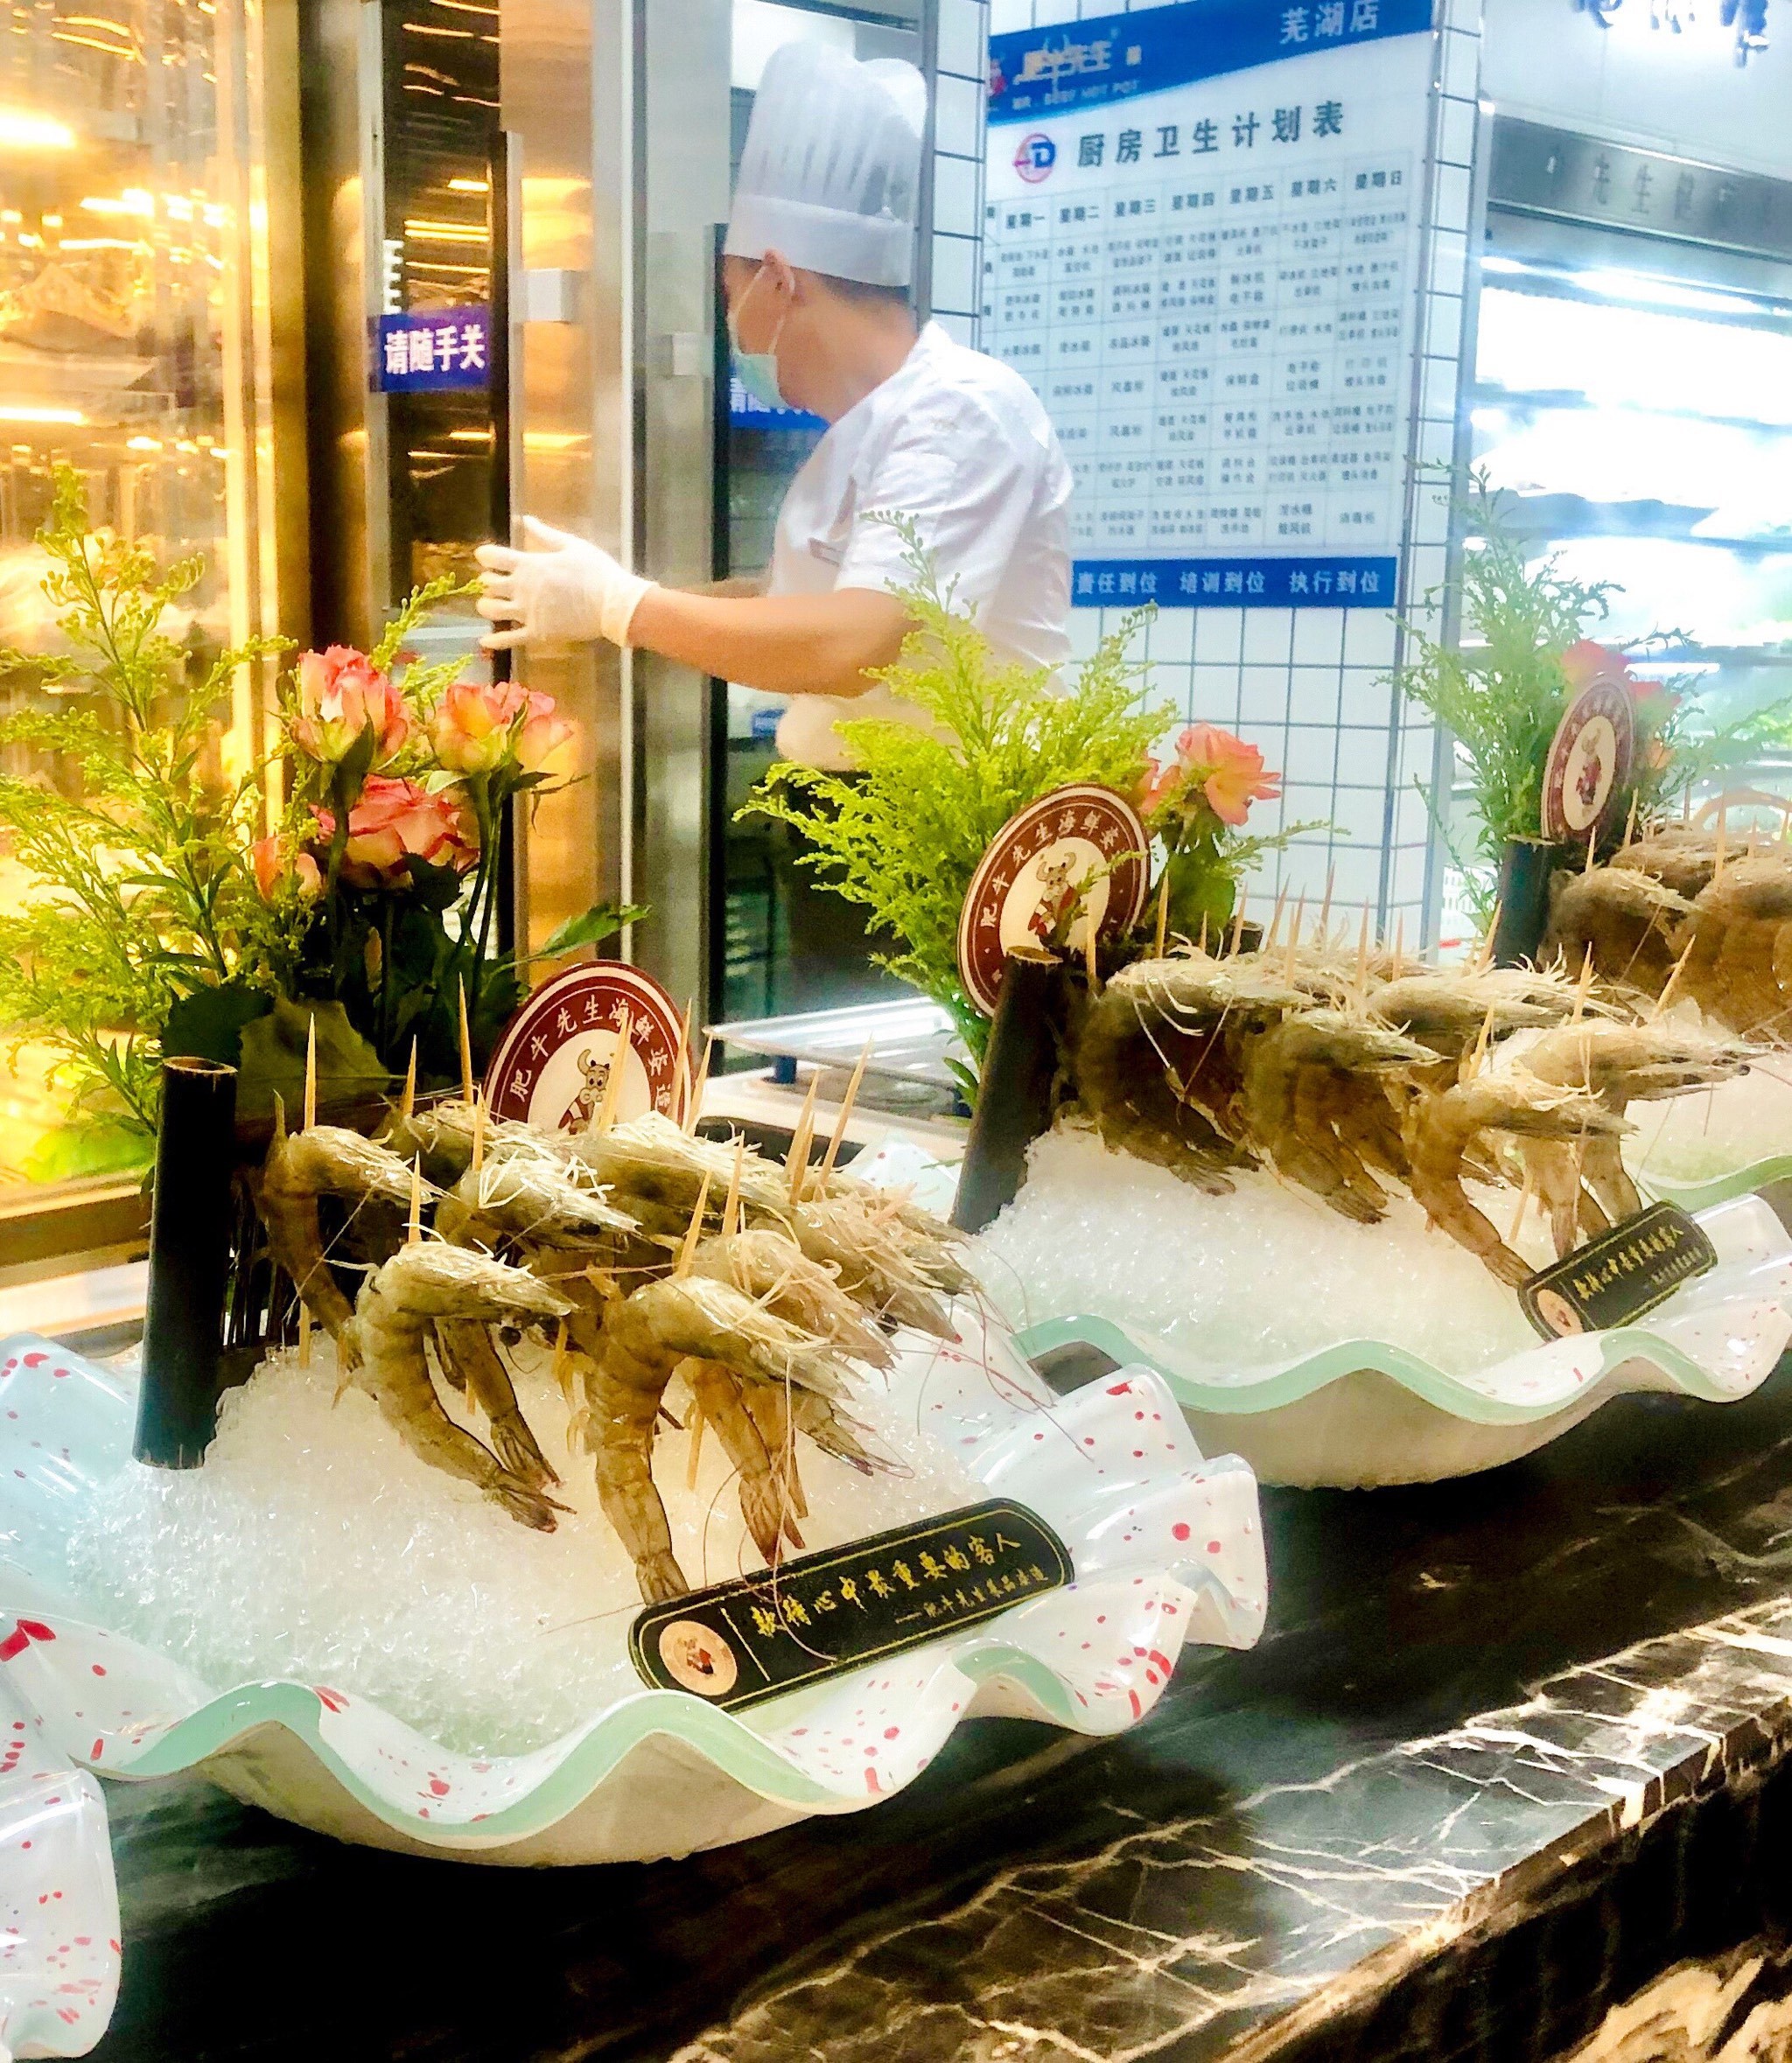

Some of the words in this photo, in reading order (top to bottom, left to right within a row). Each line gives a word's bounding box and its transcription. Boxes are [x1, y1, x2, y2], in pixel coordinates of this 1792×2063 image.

[1279, 0, 1379, 44] 芜湖店
[1077, 101, 1343, 167] 厨房卫生计划表
[1006, 213, 1045, 229] 星期一
[1060, 206, 1099, 223] 星期二
[1115, 199, 1156, 217] 星期三
[1230, 184, 1273, 204] 星期五
[1292, 178, 1337, 197] 星期六
[1355, 170, 1402, 190] 星期日
[384, 324, 486, 374] 请随手关
[1077, 571, 1158, 594] 责任到位
[1179, 571, 1265, 594] 培训到位
[1289, 570, 1380, 594] 执行到位
[980, 809, 1129, 928] 肥牛先生海鲜姿
[750, 1532, 1021, 1638] 款待心中最重要的客人
